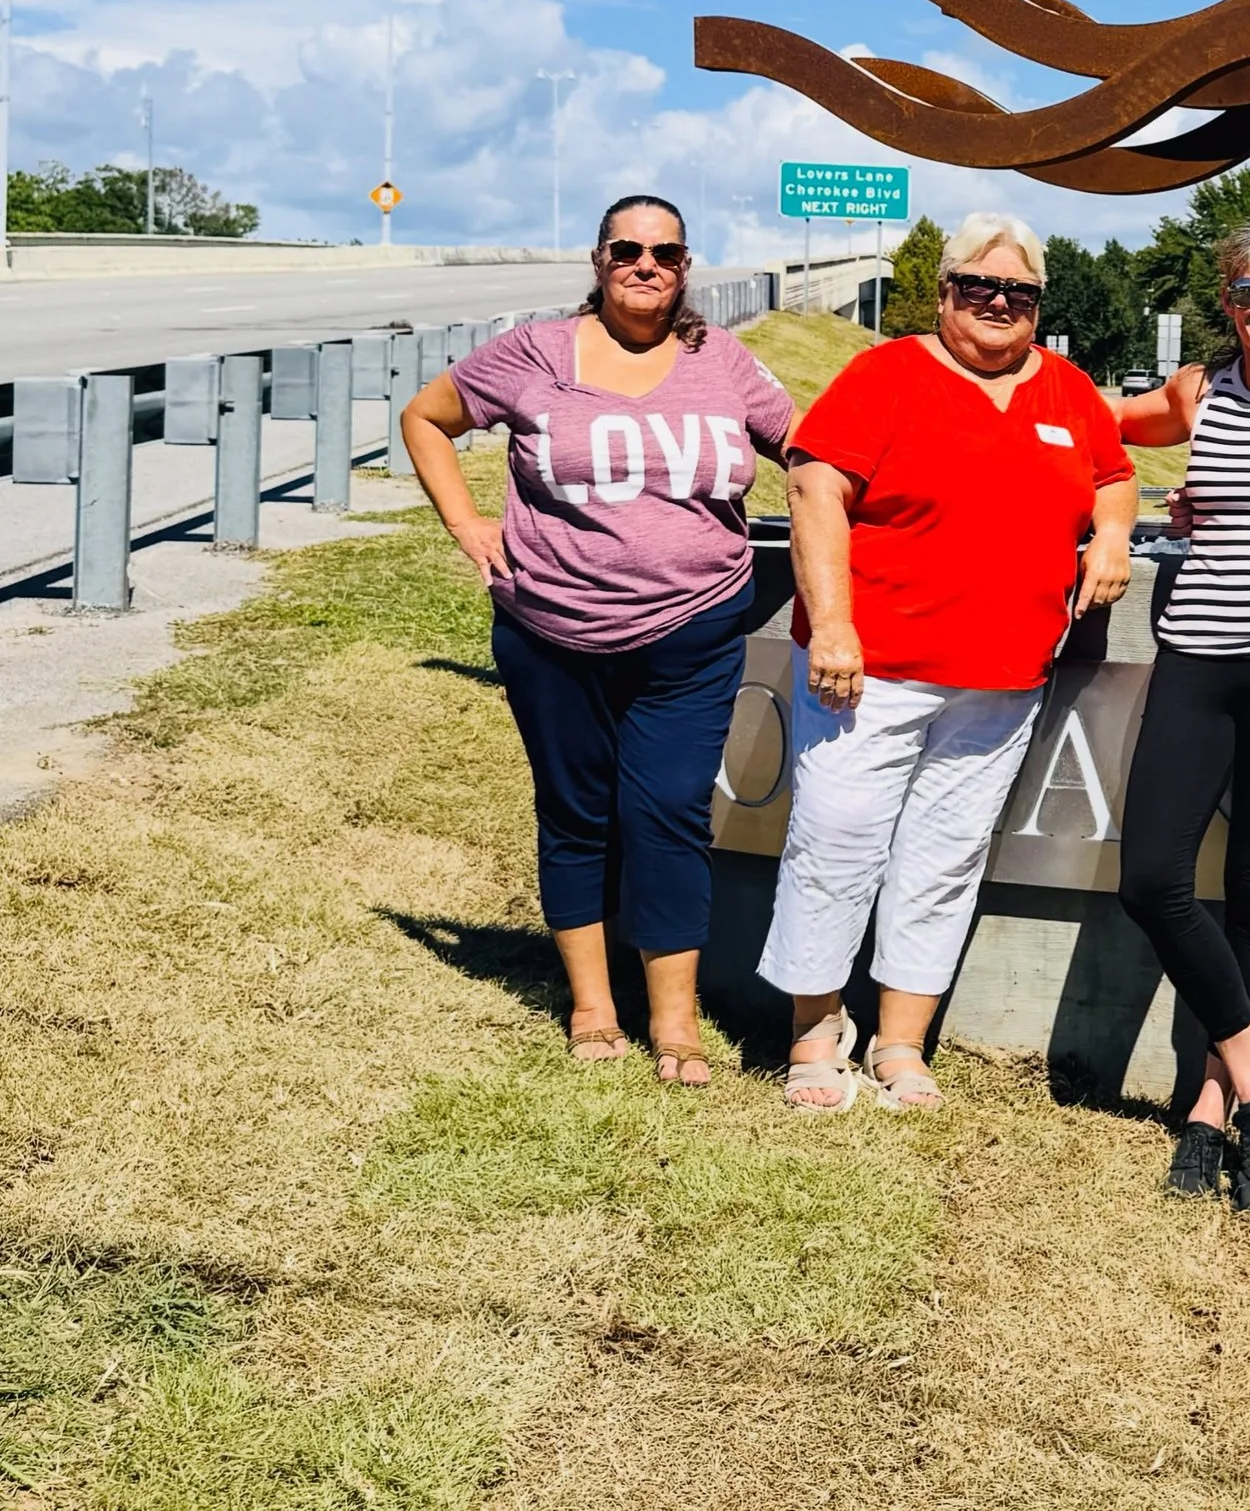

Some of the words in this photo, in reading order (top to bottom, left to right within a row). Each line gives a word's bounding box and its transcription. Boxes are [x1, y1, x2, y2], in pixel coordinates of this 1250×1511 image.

[797, 167, 849, 181] Lovers
[856, 170, 894, 183] Lane
[786, 184, 859, 198] Cherokee
[866, 187, 901, 199] Blvd
[802, 202, 839, 214] NEXT
[846, 203, 888, 216] RIGHT
[536, 412, 747, 504] LOVE
